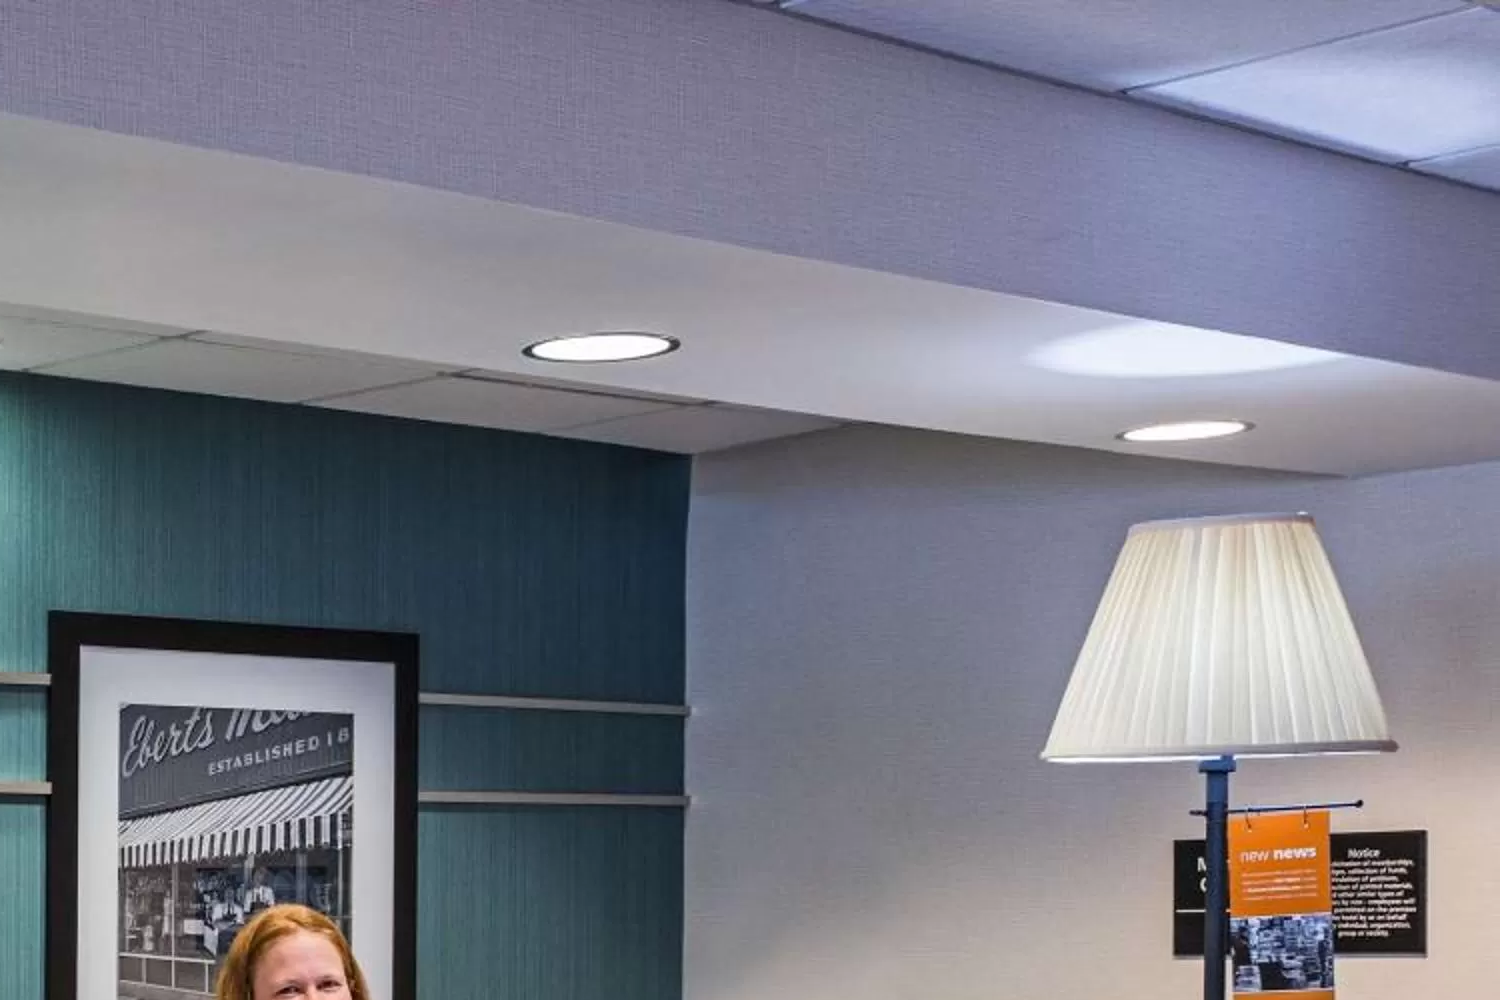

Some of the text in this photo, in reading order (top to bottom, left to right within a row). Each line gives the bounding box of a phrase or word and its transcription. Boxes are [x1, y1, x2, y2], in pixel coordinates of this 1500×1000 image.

[207, 737, 319, 776] ESTABLISHED
[1240, 847, 1317, 863] new news
[1347, 848, 1380, 859] Notice
